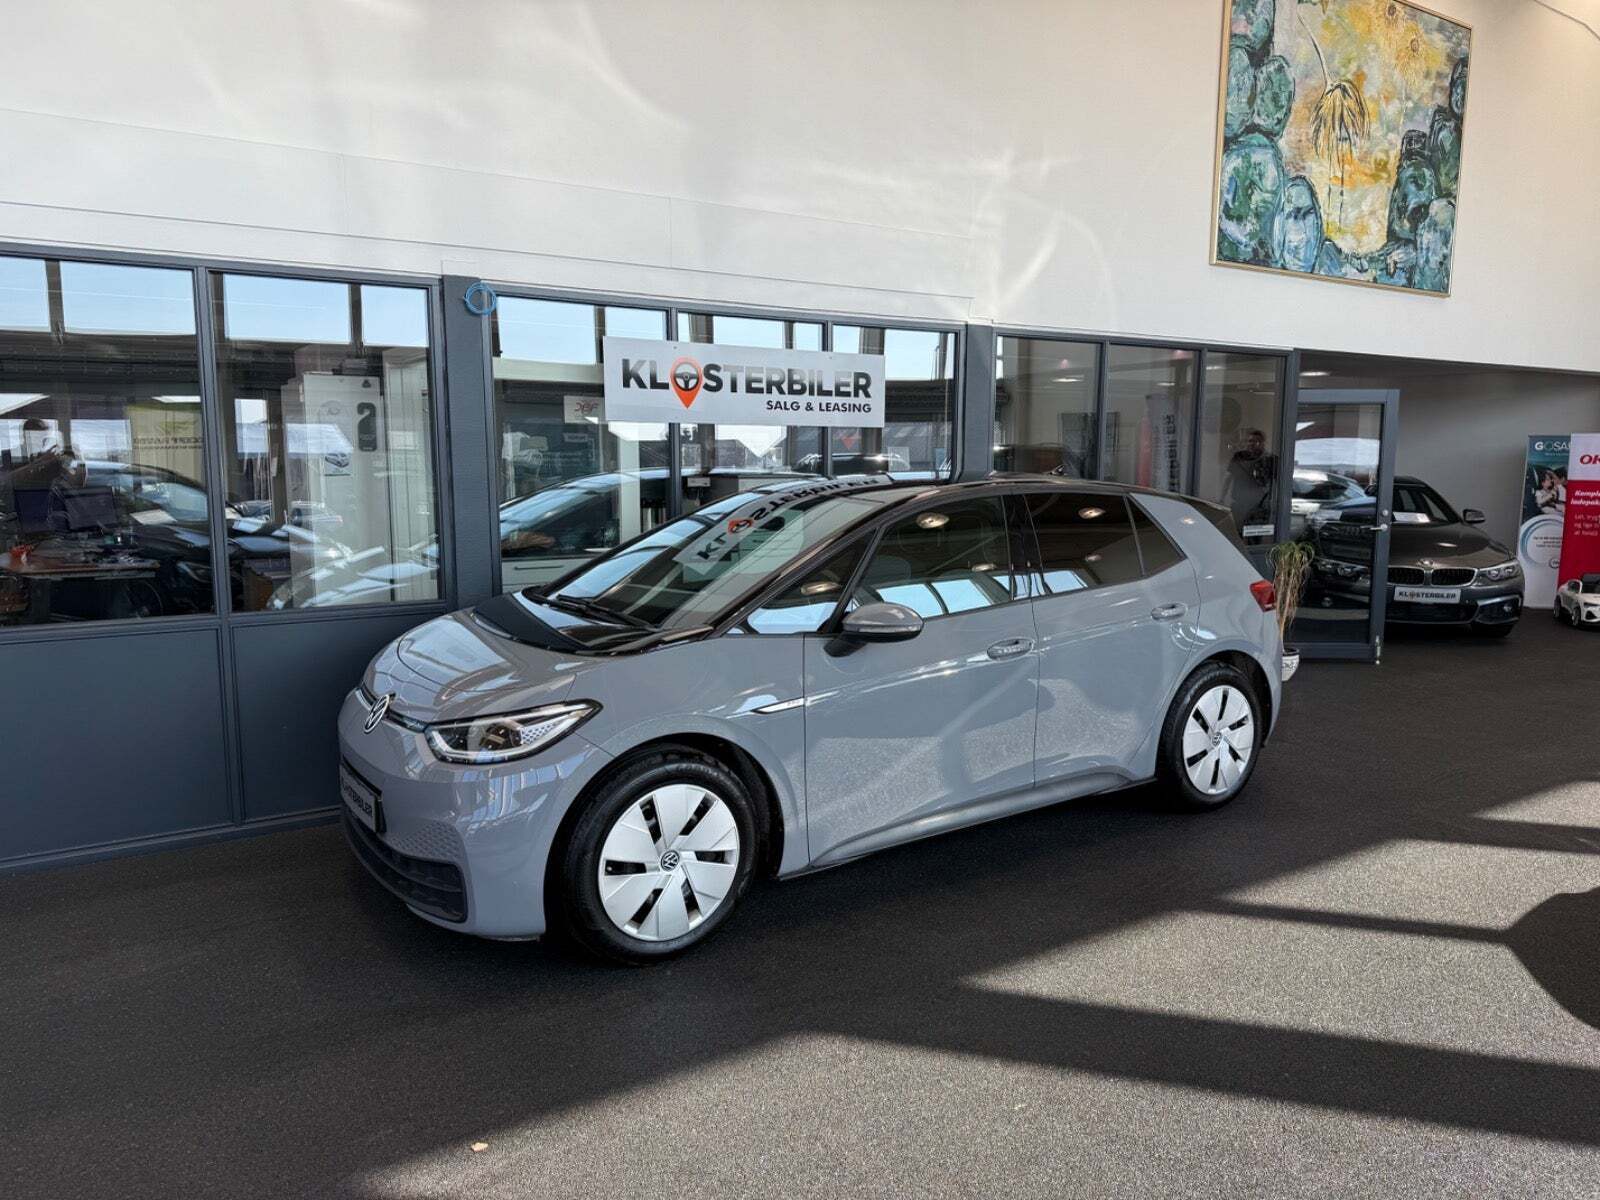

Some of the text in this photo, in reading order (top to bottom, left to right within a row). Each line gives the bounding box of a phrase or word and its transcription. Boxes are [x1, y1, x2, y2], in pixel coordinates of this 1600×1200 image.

[621, 356, 872, 400] KLOSTERBILER
[766, 400, 872, 413] SALG & LEASING
